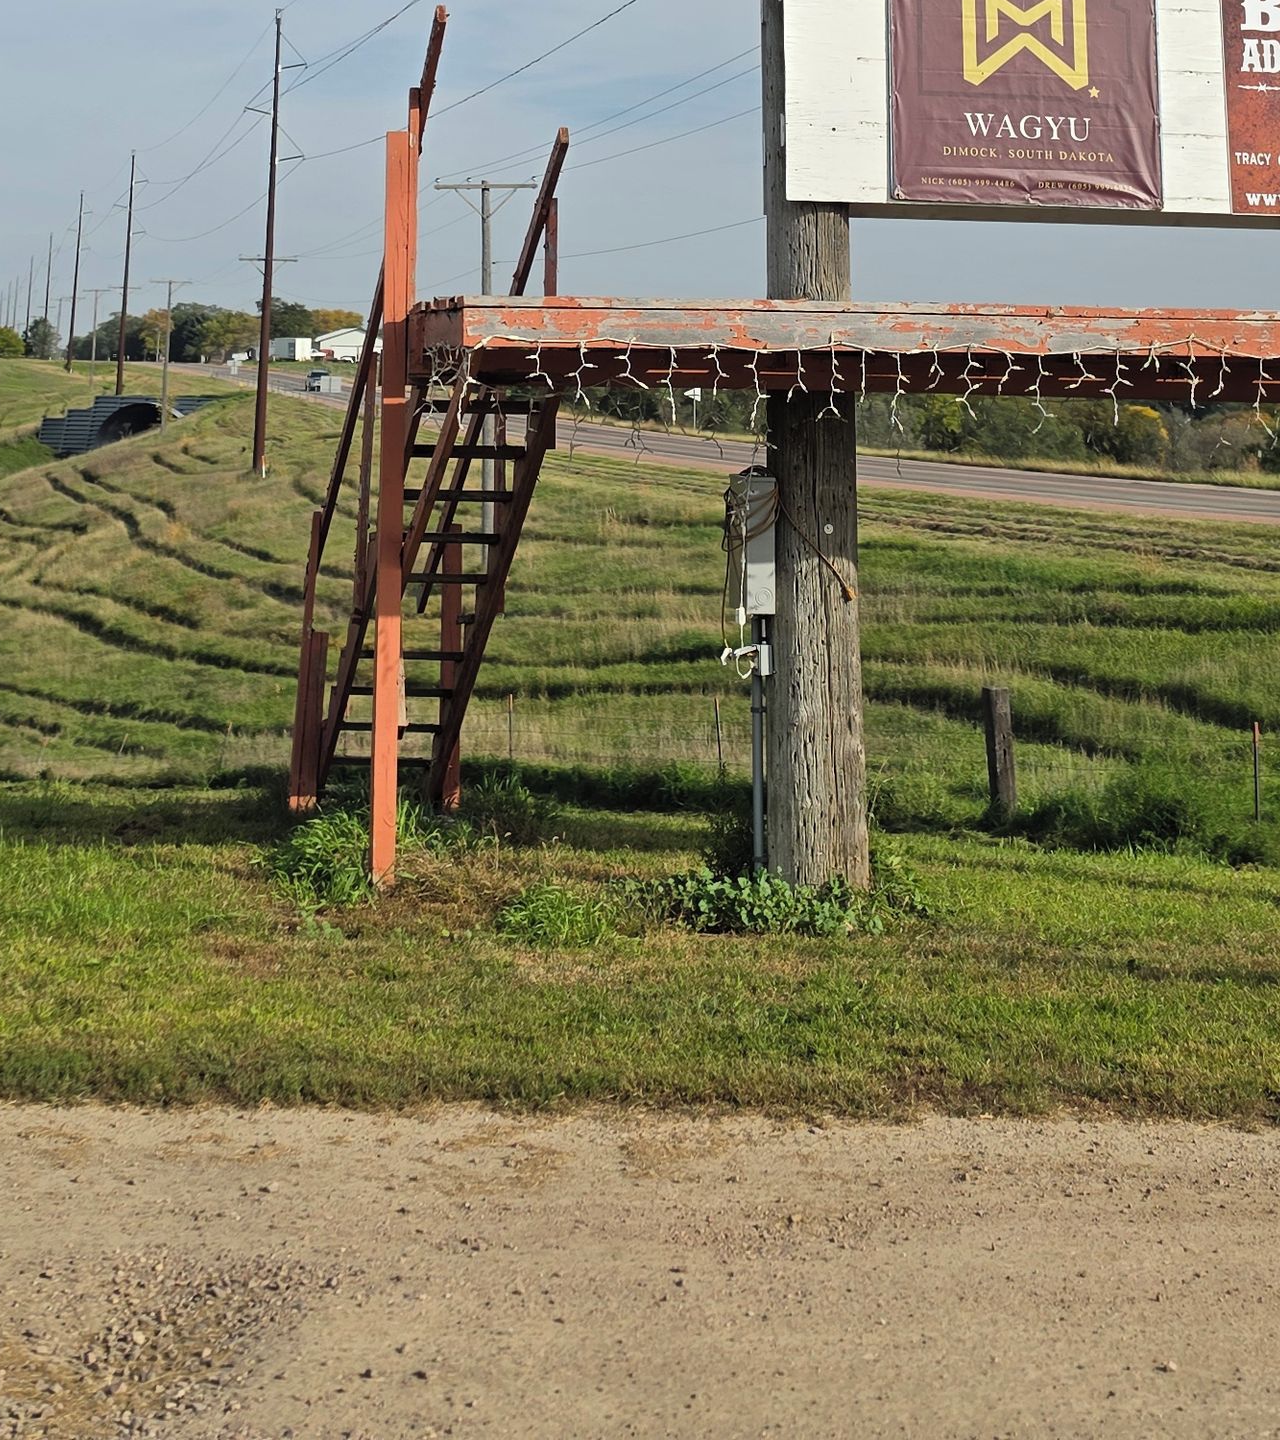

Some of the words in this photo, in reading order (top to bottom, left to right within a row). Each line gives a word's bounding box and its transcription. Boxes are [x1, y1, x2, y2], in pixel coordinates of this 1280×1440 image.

[963, 112, 1091, 142] WAGYU
[1008, 149, 1053, 160] SOUTH
[1059, 151, 1114, 162] DAKOTA
[1235, 152, 1271, 166] TRACY
[921, 176, 945, 185] NICK
